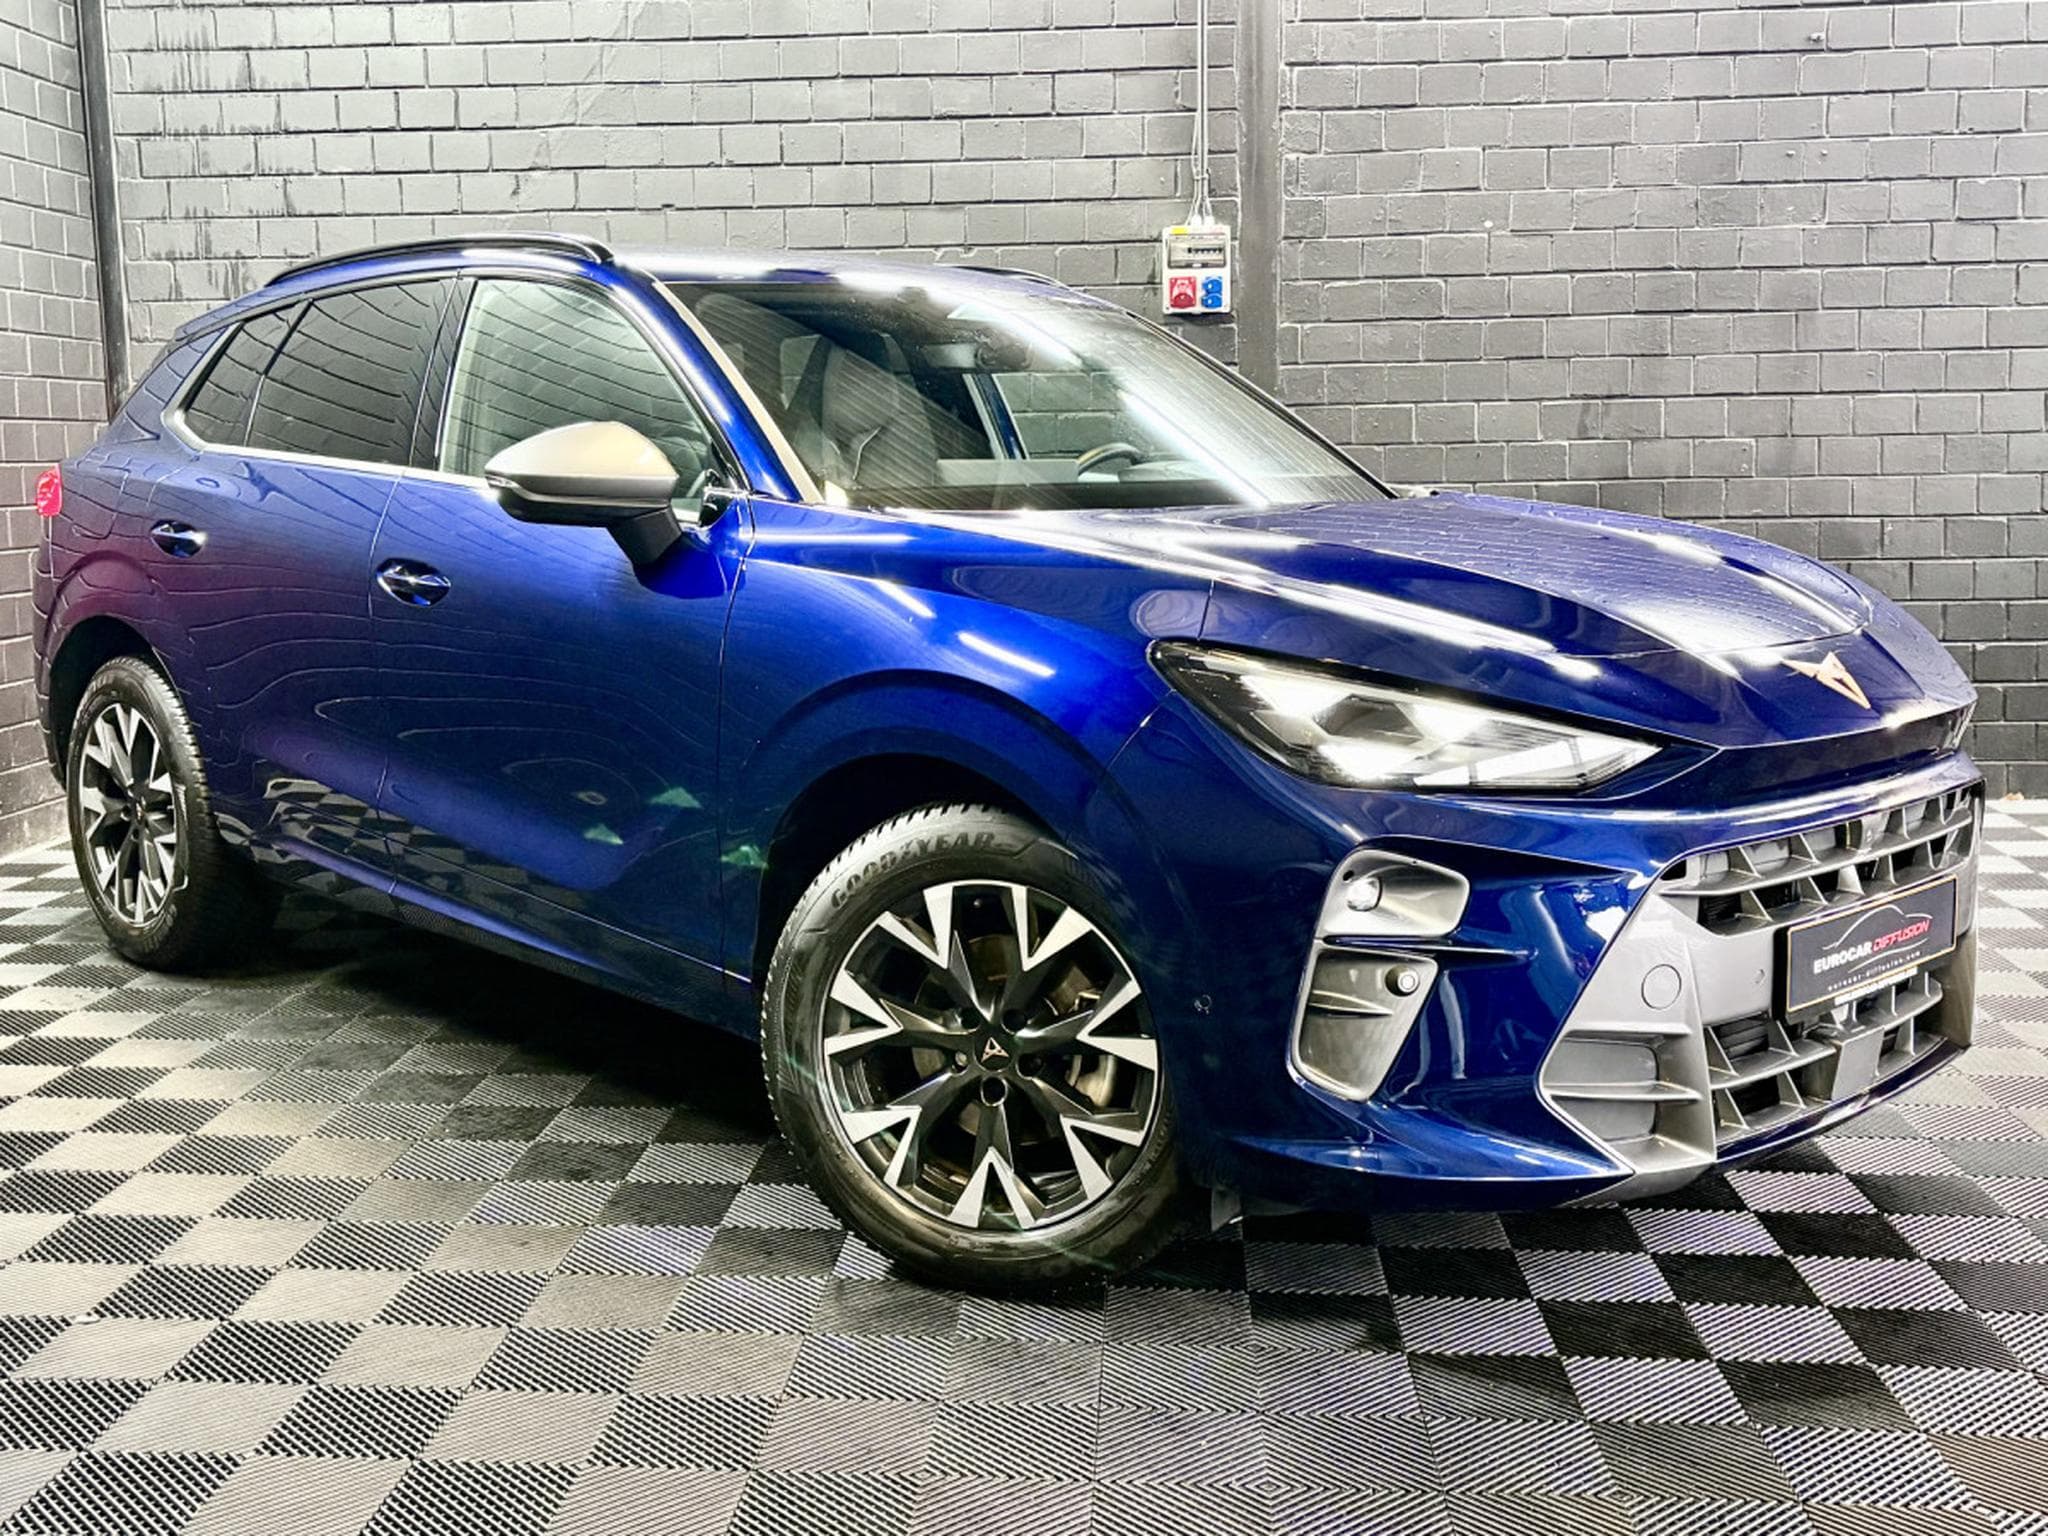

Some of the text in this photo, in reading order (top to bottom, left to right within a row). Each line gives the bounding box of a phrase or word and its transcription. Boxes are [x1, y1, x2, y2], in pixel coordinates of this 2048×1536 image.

[831, 832, 996, 909] GOODYEAR
[1813, 919, 1931, 975] EUROCAR DIFFUSION
